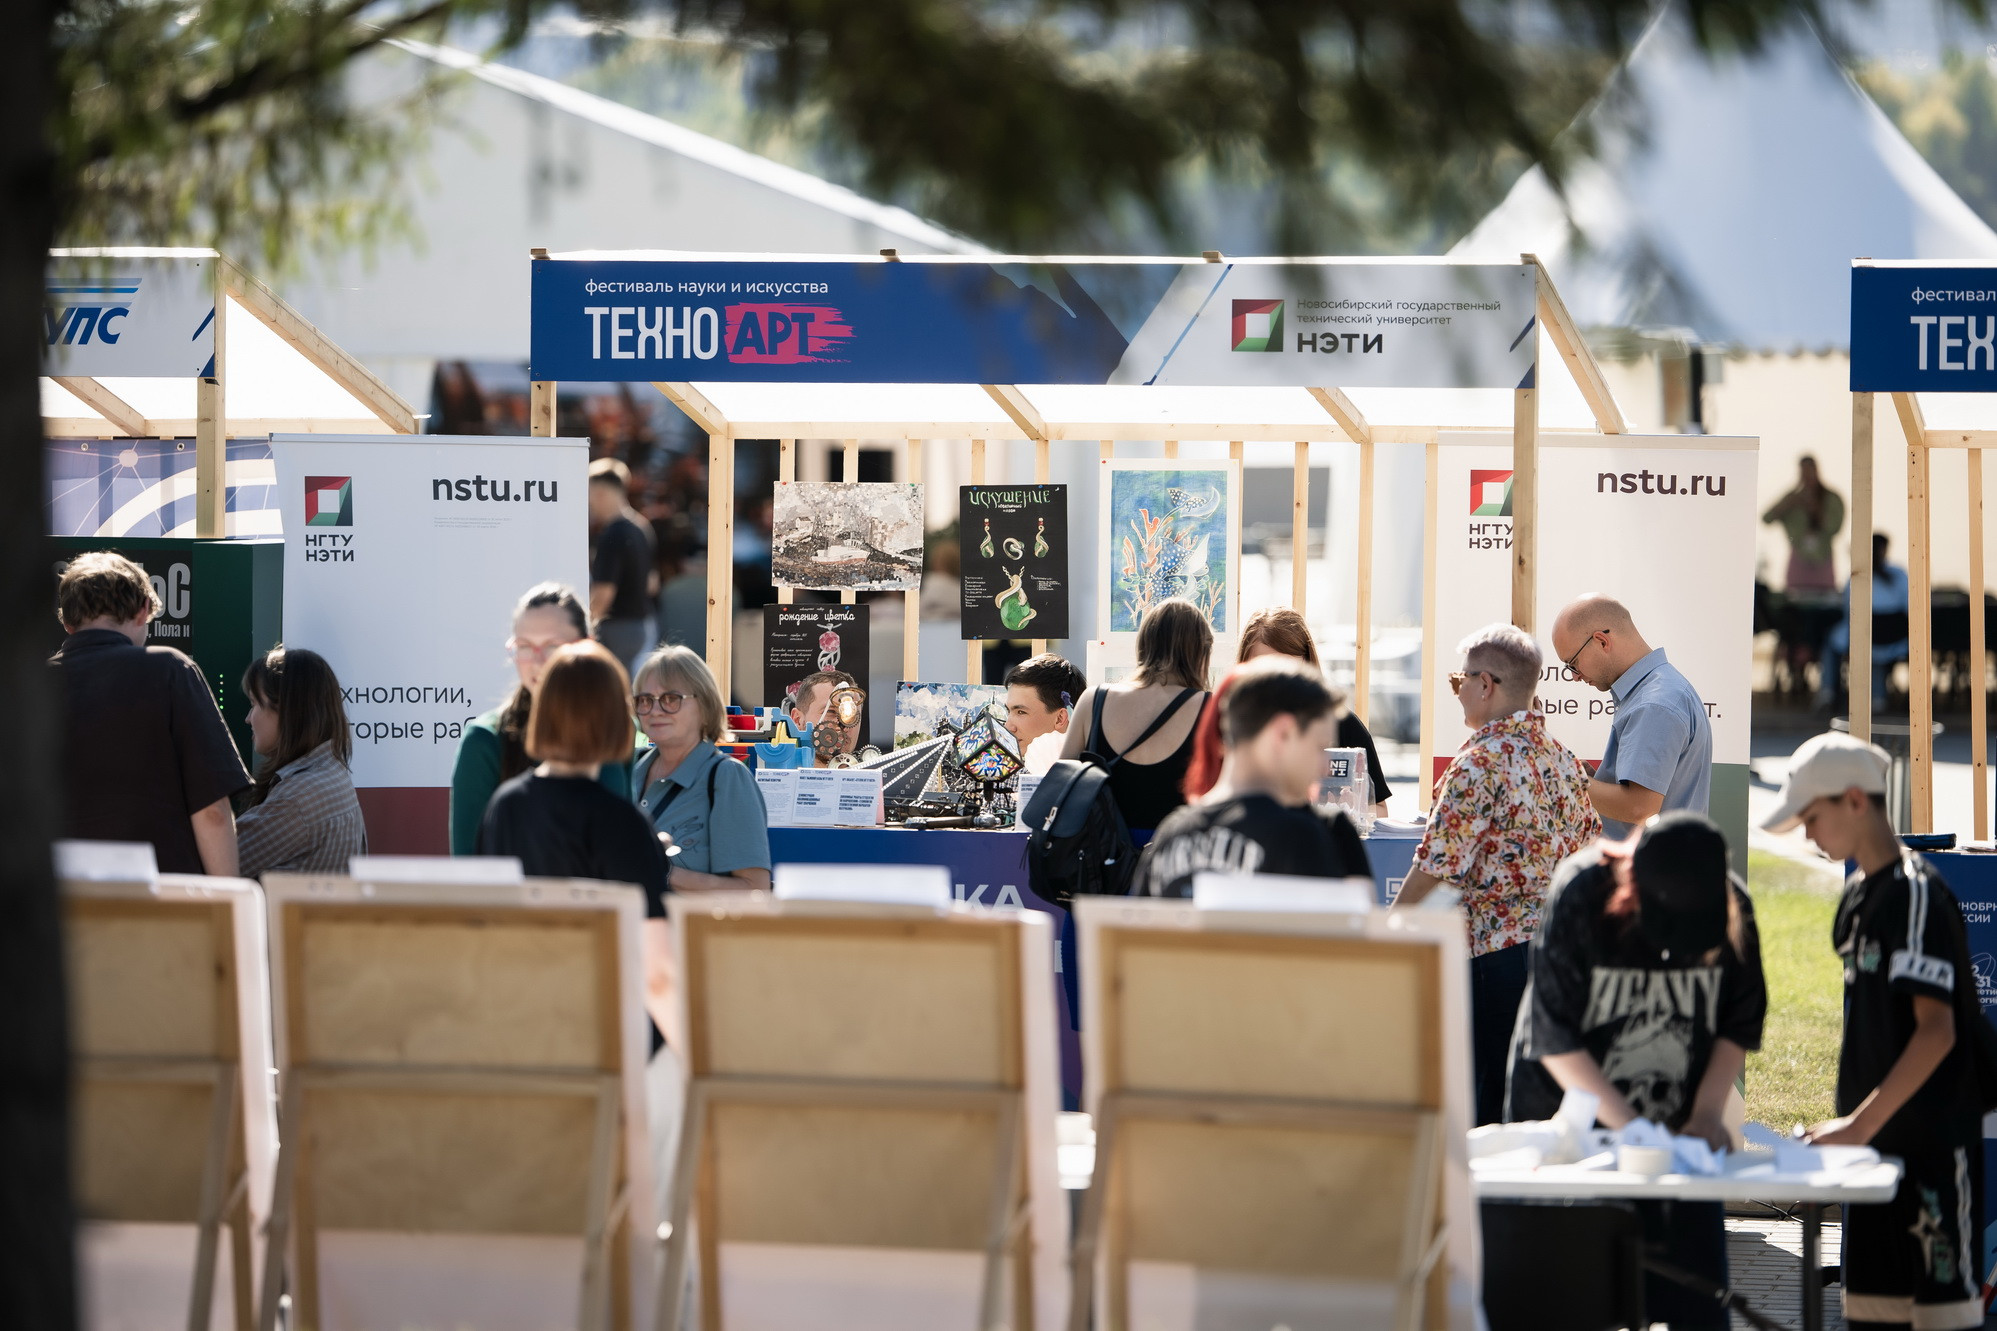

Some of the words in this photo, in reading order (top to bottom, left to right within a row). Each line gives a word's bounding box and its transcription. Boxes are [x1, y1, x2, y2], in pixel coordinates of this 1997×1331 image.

[584, 278, 674, 296] фестиваль
[678, 281, 726, 297] науки
[731, 281, 742, 293] и
[746, 281, 829, 297] искусства
[1911, 286, 1997, 305] фестивал
[1296, 299, 1393, 310] Новосибирский
[1396, 300, 1501, 312] государственный
[1296, 314, 1373, 324] технический
[1376, 315, 1452, 327] университет
[1296, 332, 1383, 354] НЭТИ
[1910, 315, 1996, 370] ТЕХ
[432, 474, 558, 502] nstu.ru
[1597, 469, 1726, 496] nstu.ru
[969, 490, 1050, 509] ИСКУШЕНИЕ
[1469, 523, 1513, 536] НГТУ
[305, 534, 354, 547] НГТУ
[1468, 537, 1513, 550] НЭТИ
[305, 549, 355, 562] НЭТИ
[778, 613, 819, 626] рождение
[824, 608, 856, 622] цветка
[154, 620, 181, 638] Пола
[183, 625, 190, 638] и
[1329, 760, 1348, 769] NE
[1329, 768, 1347, 777] TI
[1579, 965, 1724, 1035] HEAVY
